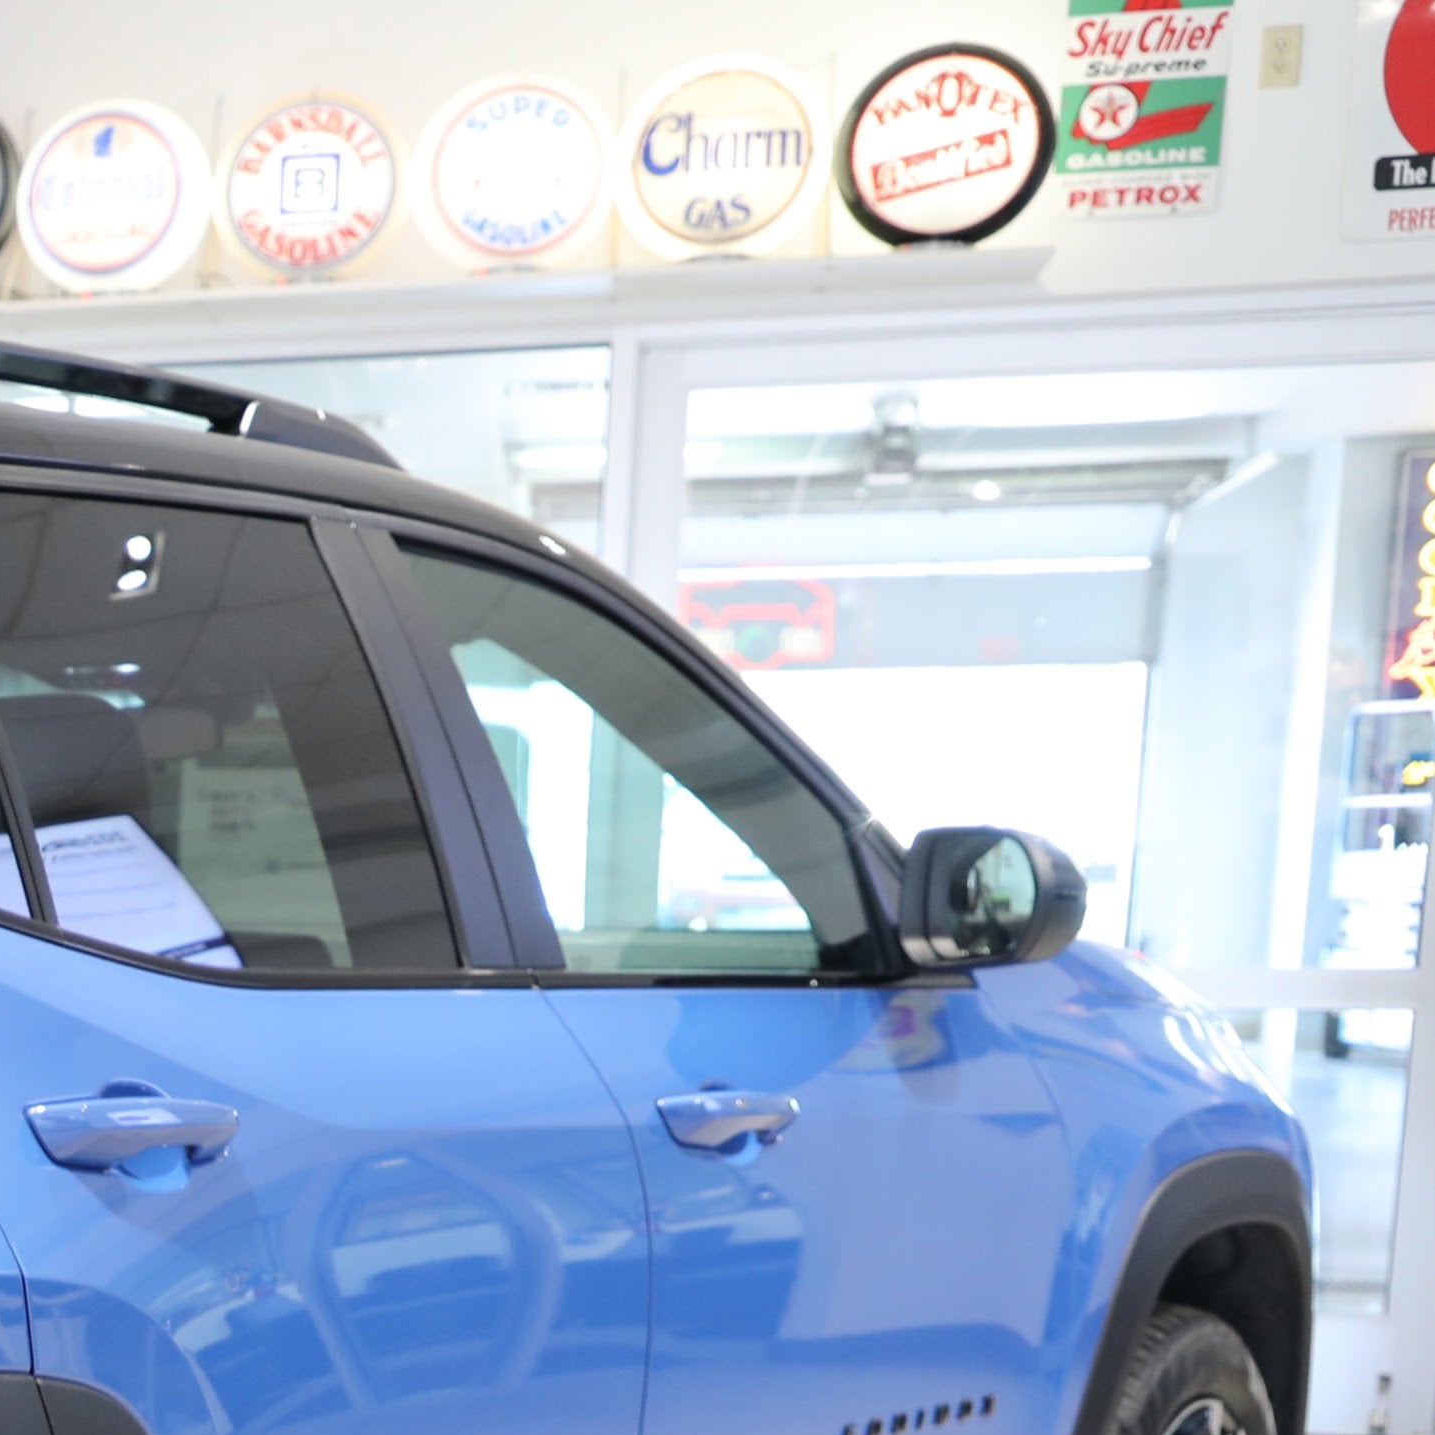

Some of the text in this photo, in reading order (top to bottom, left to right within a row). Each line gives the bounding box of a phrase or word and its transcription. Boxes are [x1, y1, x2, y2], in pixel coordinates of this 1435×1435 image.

[1067, 11, 1229, 59] Sky Chief
[642, 112, 803, 176] Charm
[1065, 146, 1207, 170] GASOLINE
[1391, 159, 1428, 187] The
[1069, 183, 1201, 208] PETROX
[684, 194, 751, 229] GAS
